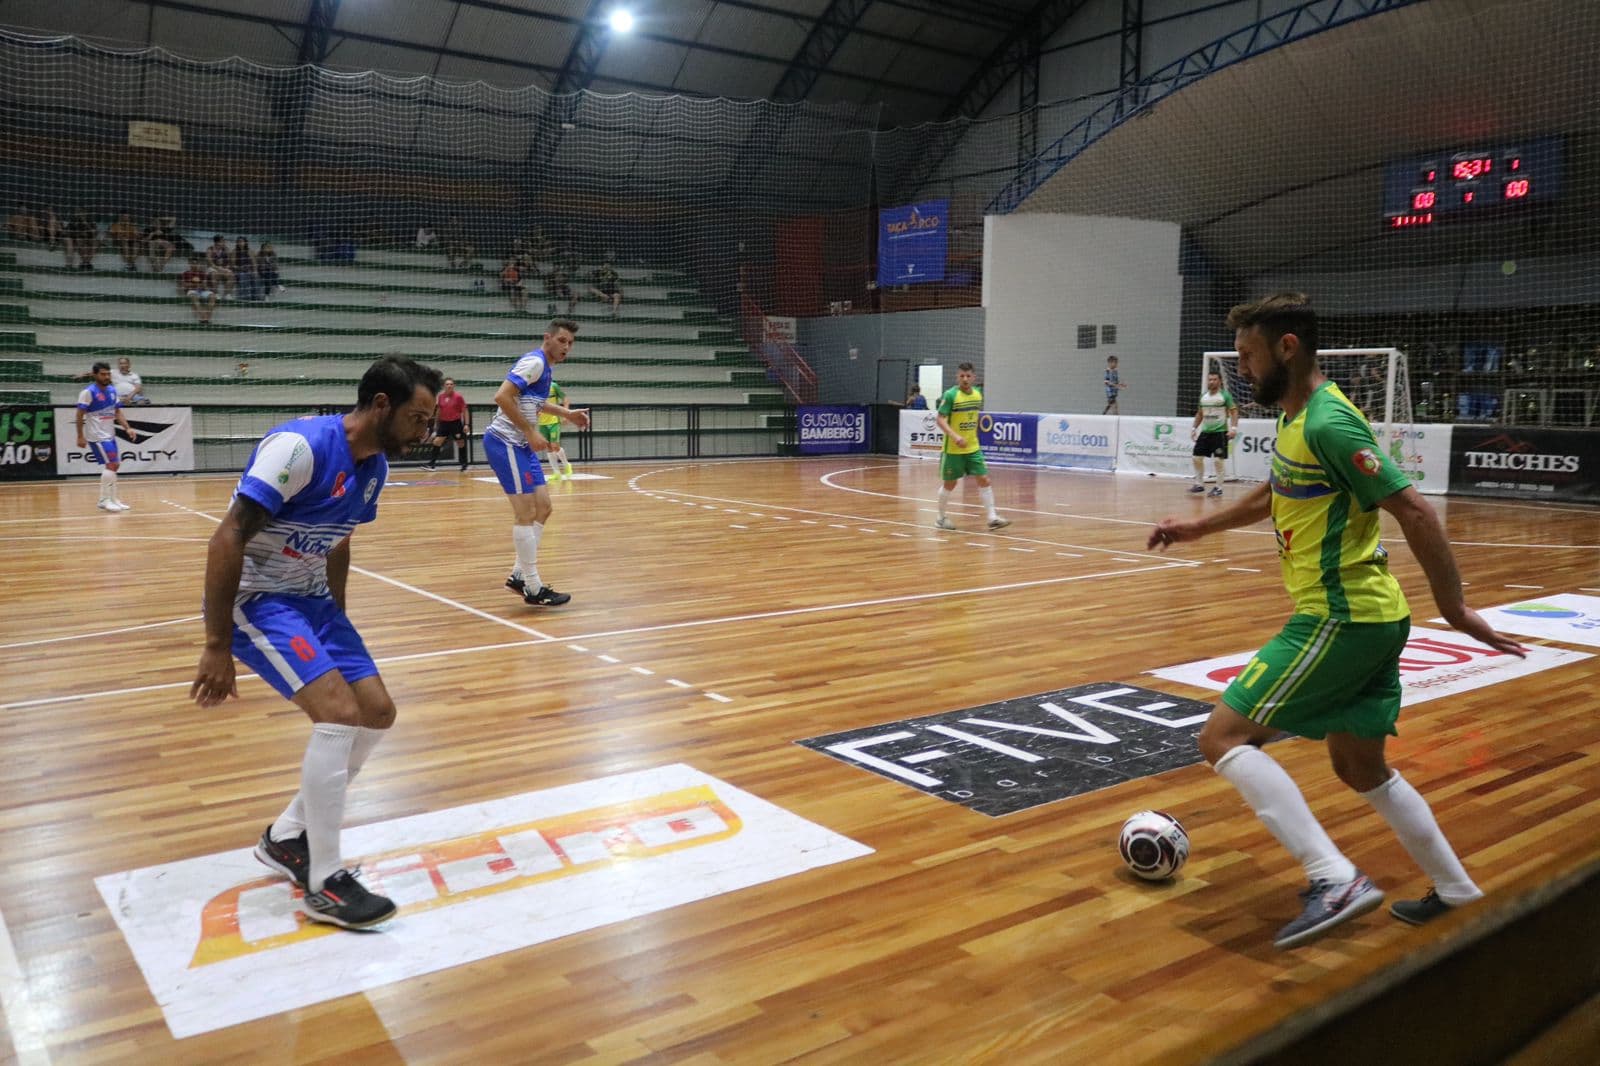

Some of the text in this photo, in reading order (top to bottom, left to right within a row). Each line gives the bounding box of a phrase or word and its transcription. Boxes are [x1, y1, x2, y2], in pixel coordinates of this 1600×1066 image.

[801, 413, 855, 427] GUSTAVO
[801, 427, 855, 440] BAMBERG
[1047, 430, 1109, 448] tecnicon
[0, 441, 32, 465] ÃO
[67, 450, 176, 463] PEALTY
[1465, 451, 1580, 472] TRICHES
[825, 687, 1212, 788] FIVE
